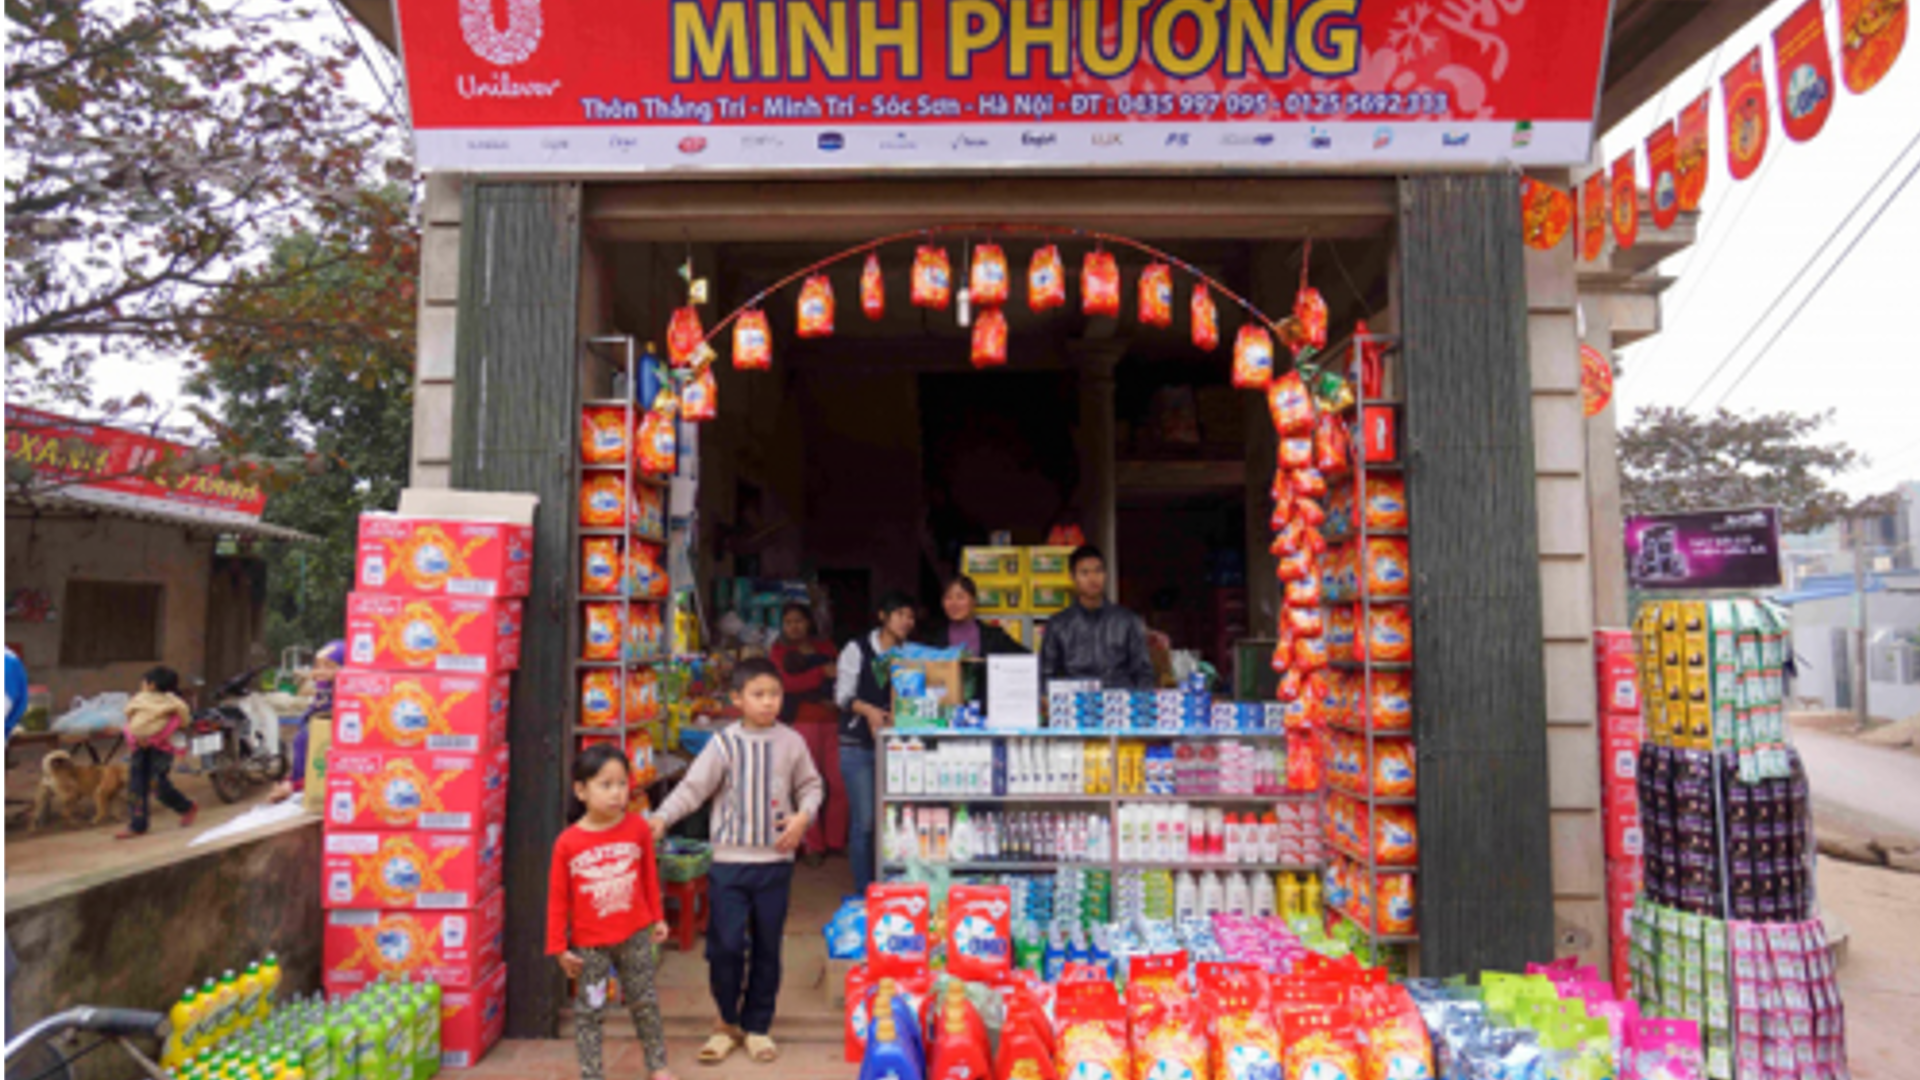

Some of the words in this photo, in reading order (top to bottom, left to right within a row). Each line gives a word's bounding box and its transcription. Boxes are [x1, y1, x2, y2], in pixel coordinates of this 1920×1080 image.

[670, 0, 923, 83] MINH
[763, 95, 822, 119] Minh
[978, 94, 1009, 118] Hà
[1069, 93, 1104, 117] ĐT
